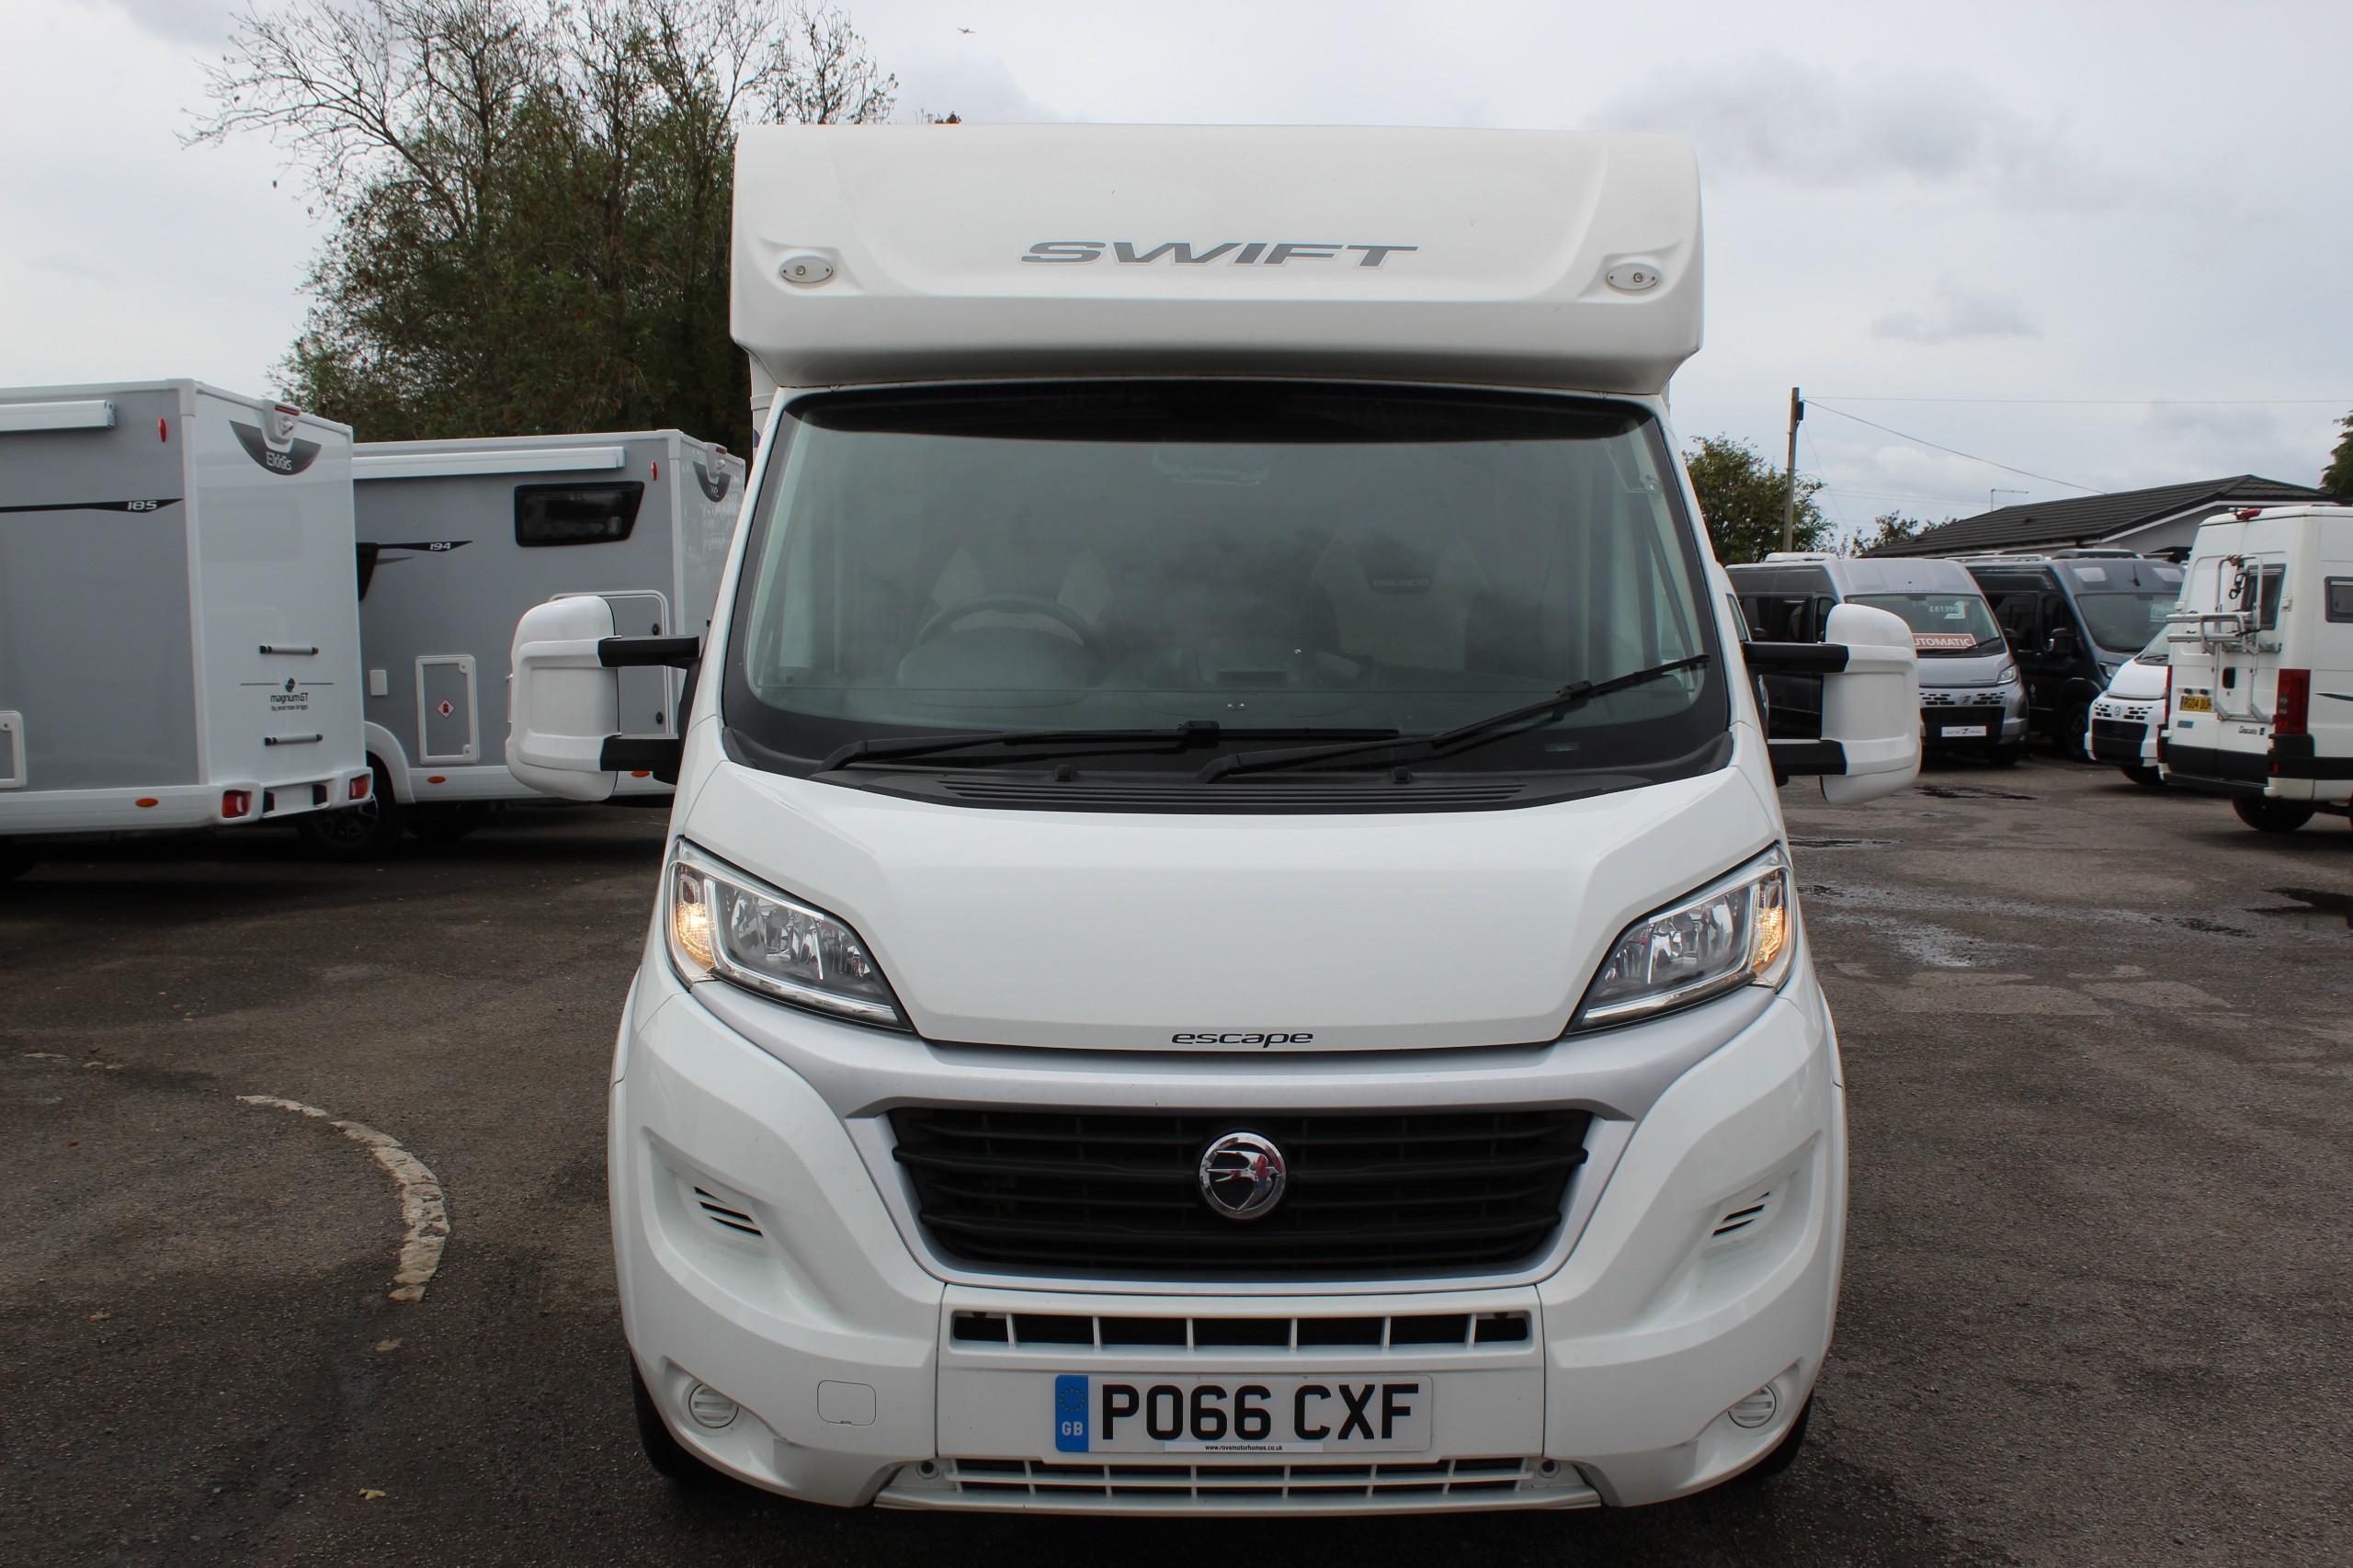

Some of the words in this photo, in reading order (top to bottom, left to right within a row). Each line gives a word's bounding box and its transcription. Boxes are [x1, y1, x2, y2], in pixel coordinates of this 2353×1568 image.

[1019, 241, 1419, 268] SWIFT
[429, 542, 451, 551] 194
[1914, 637, 1972, 646] UTOMATIC
[270, 695, 299, 704] magnum
[300, 692, 309, 702] GT
[1172, 1032, 1313, 1049] escape
[1102, 1384, 1272, 1440] PO66
[1293, 1382, 1419, 1440] CXF
[1062, 1421, 1083, 1436] GB
